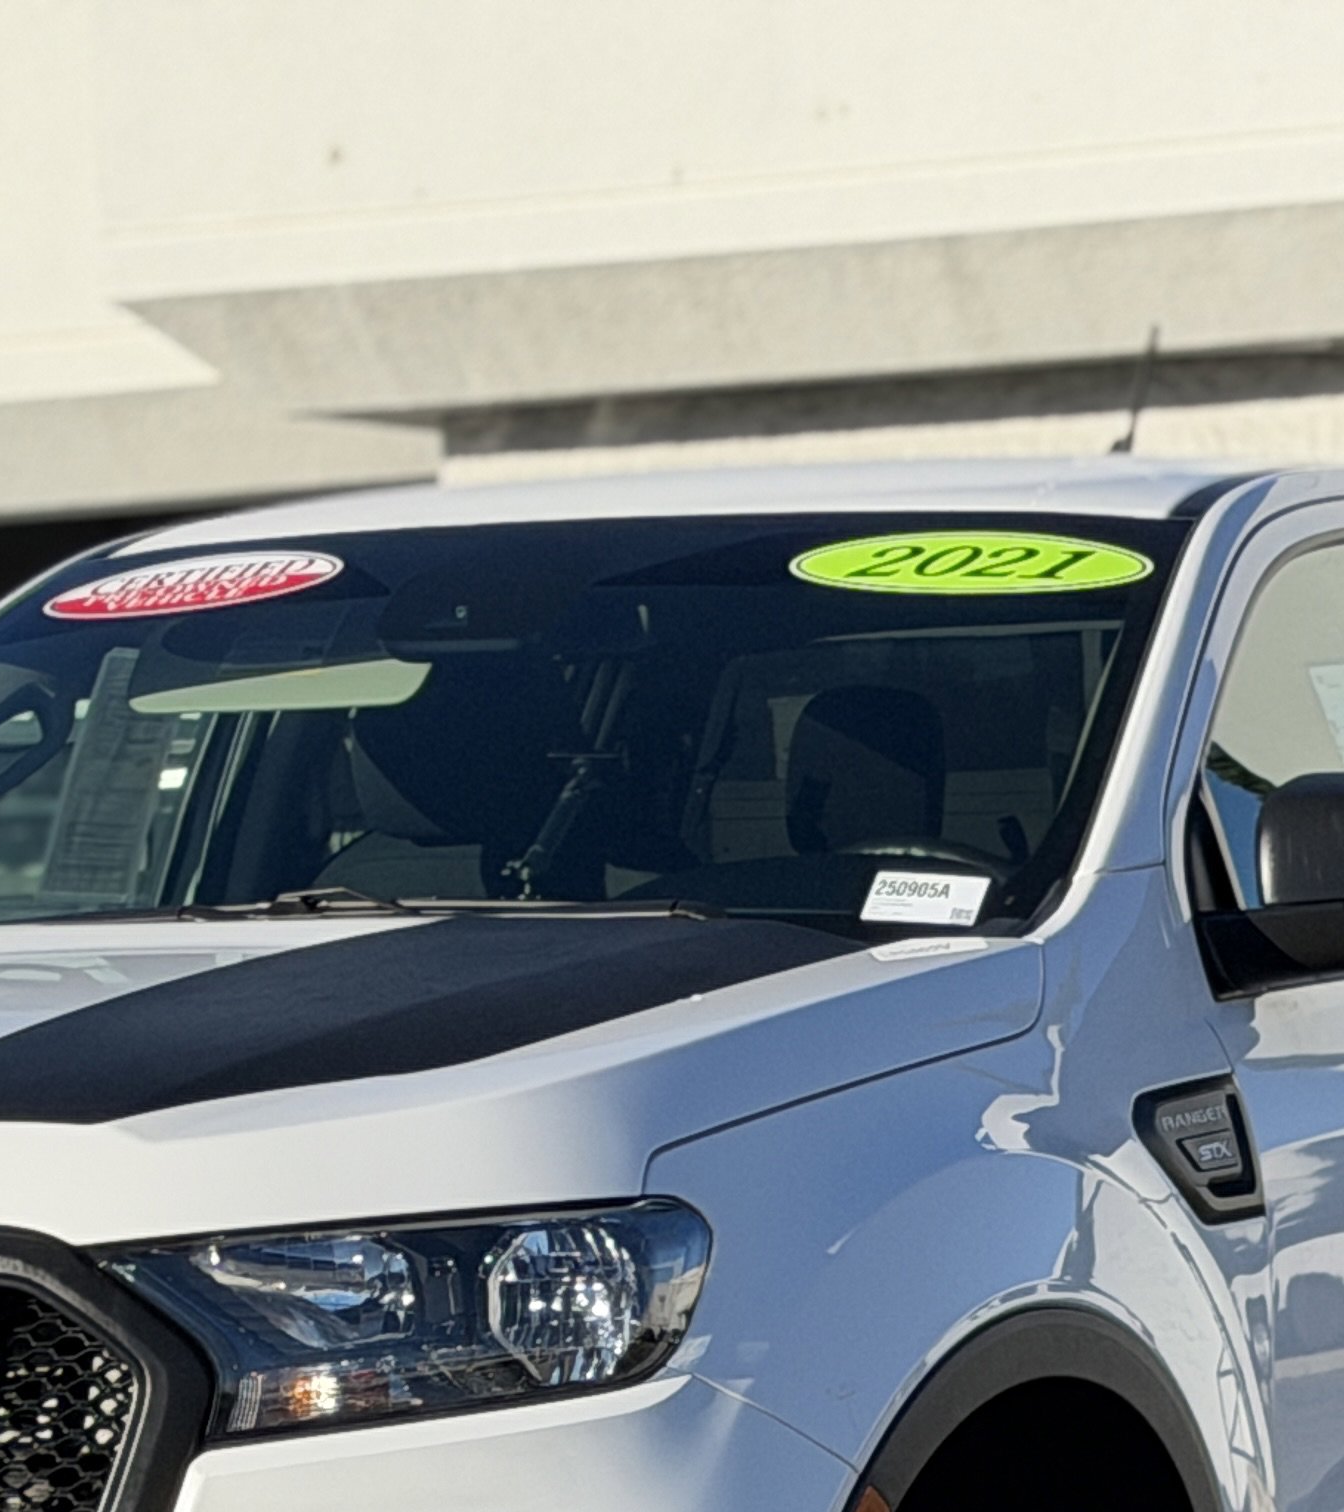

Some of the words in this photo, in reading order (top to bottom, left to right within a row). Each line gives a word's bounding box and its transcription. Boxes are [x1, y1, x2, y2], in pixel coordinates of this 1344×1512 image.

[843, 545, 1096, 580] 2021
[874, 879, 951, 899] 250905A
[1197, 1139, 1233, 1161] STX
